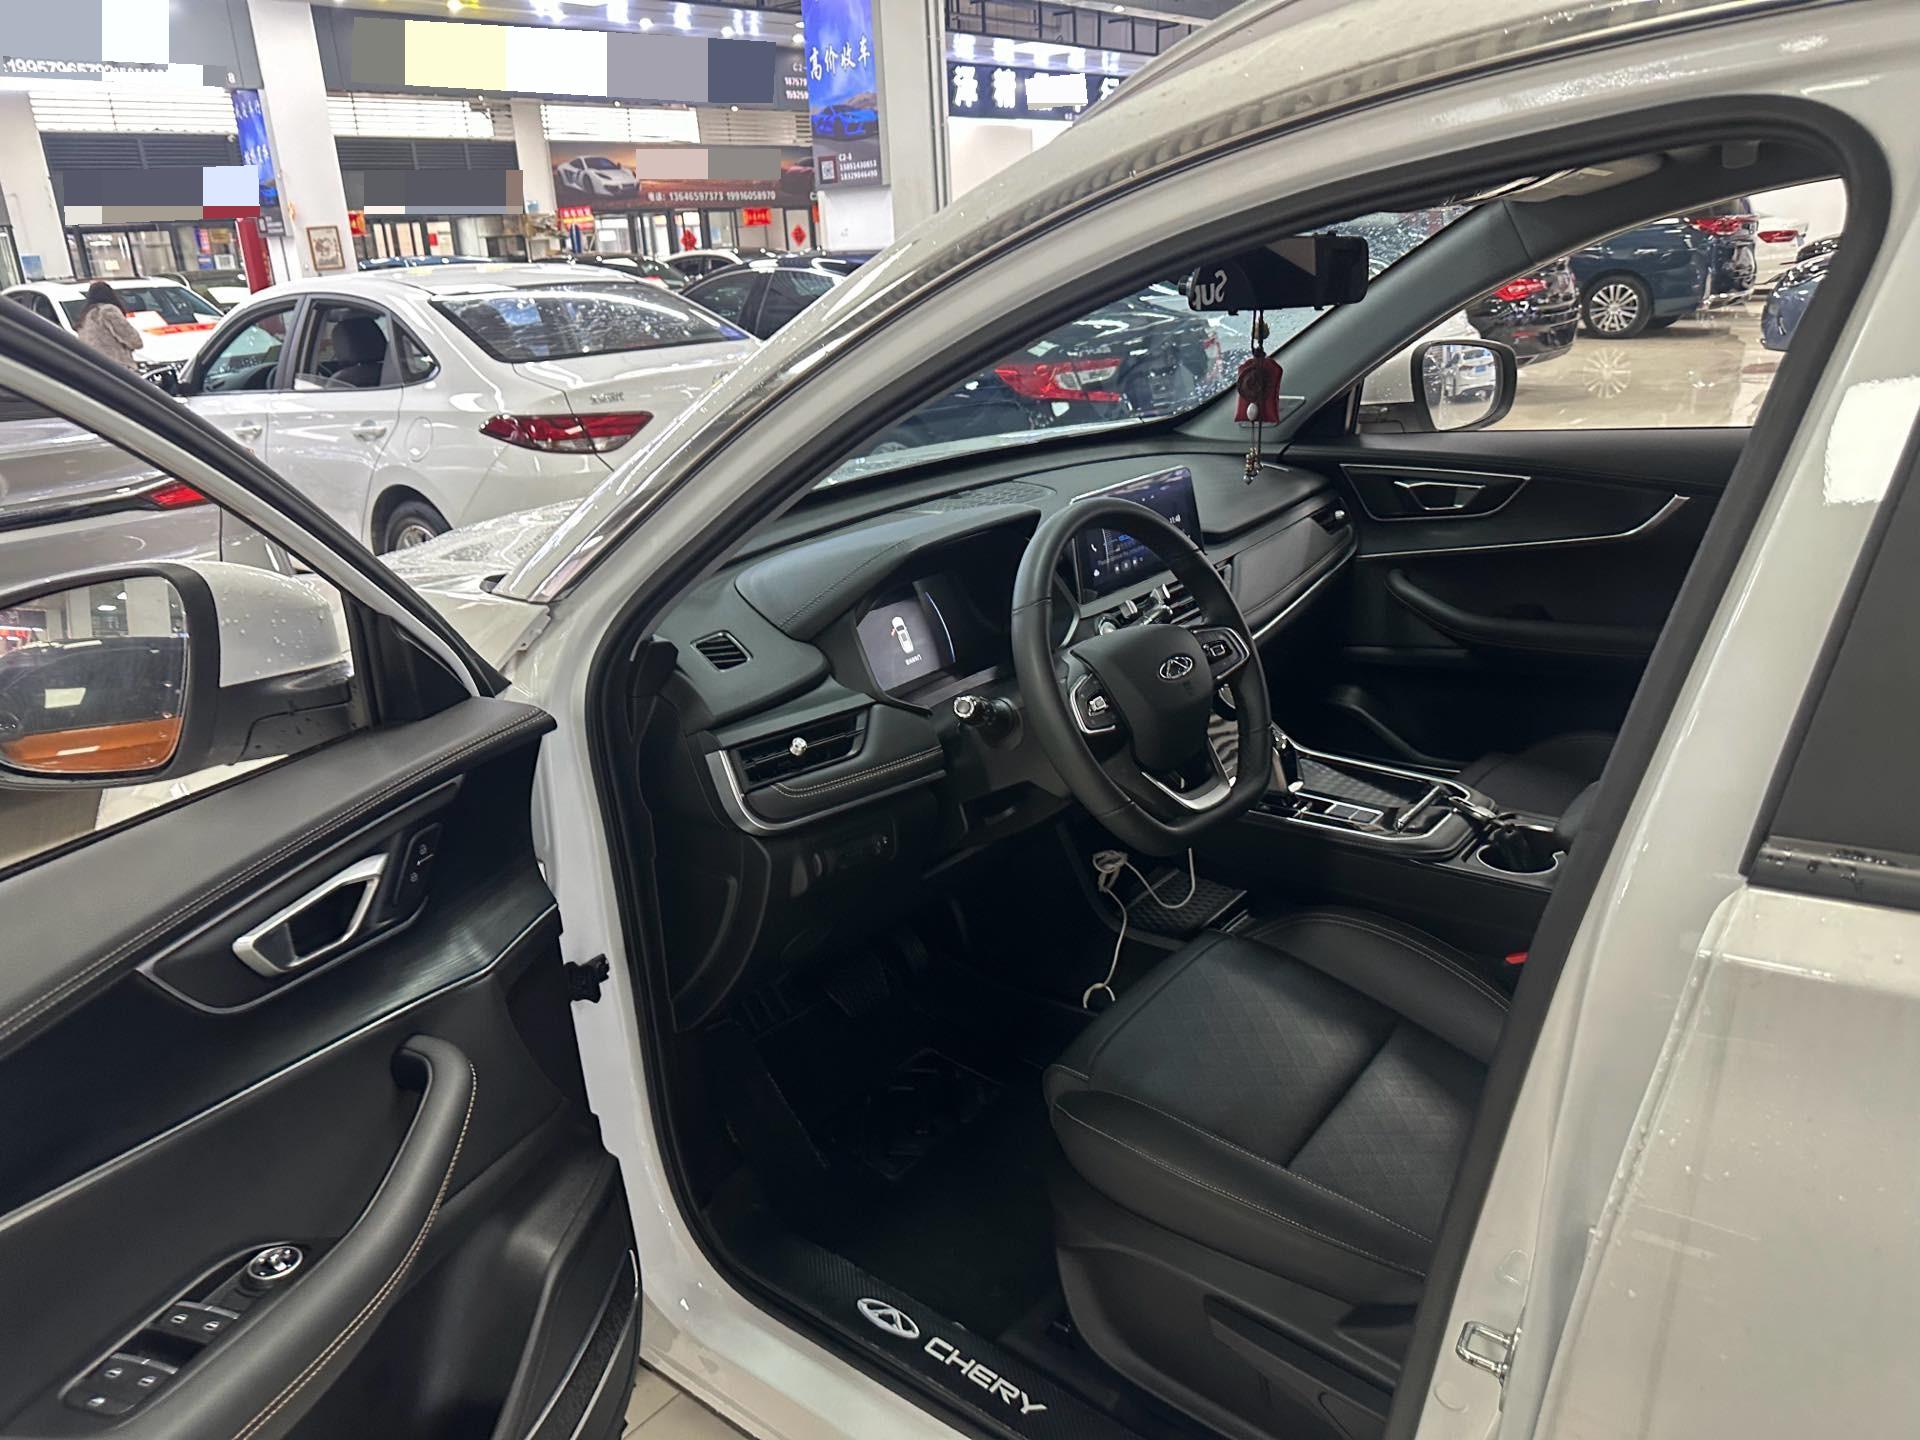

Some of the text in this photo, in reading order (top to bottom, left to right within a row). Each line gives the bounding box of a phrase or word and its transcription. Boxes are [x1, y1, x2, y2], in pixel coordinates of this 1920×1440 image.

[809, 35, 871, 81] 高价收车
[924, 1337, 1047, 1415] CHERY
